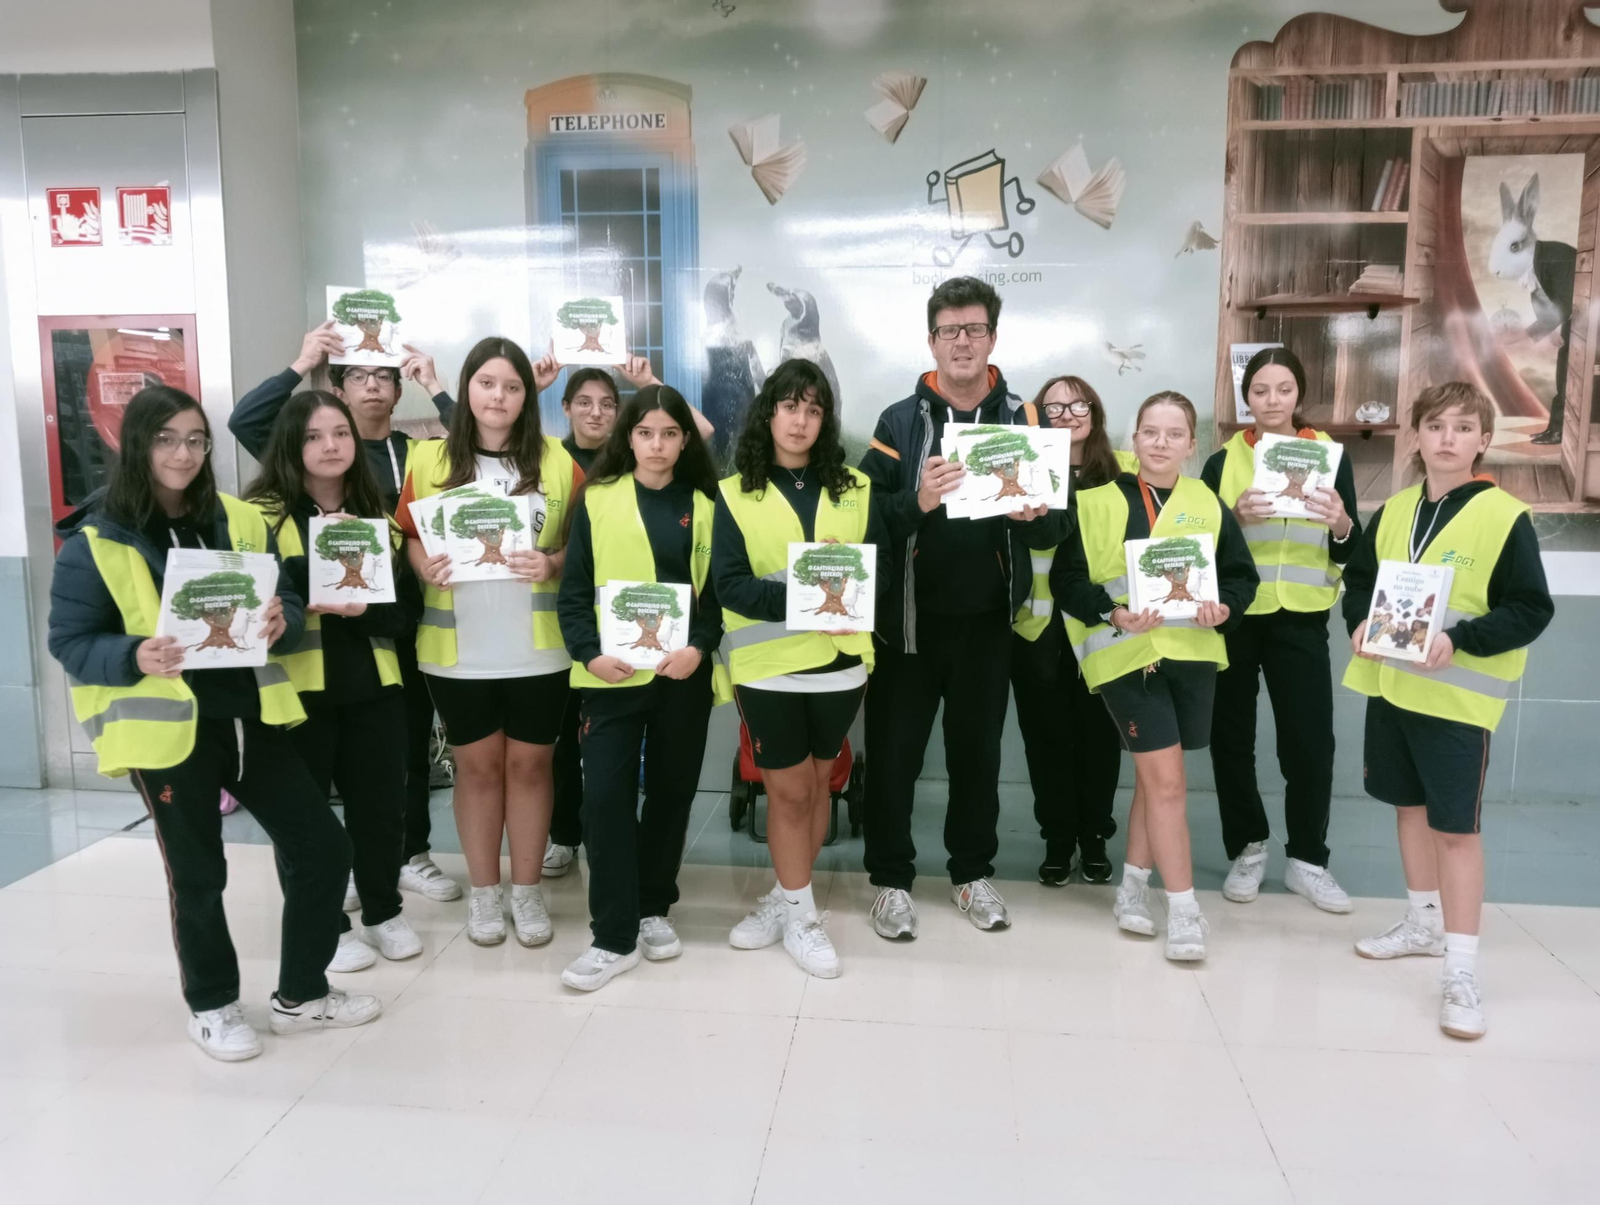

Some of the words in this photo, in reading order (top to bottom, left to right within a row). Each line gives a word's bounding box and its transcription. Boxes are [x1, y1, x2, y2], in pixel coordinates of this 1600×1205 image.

[551, 113, 665, 131] TELEPHONE
[1188, 516, 1206, 525] DGT
[1455, 555, 1475, 567] DGT
